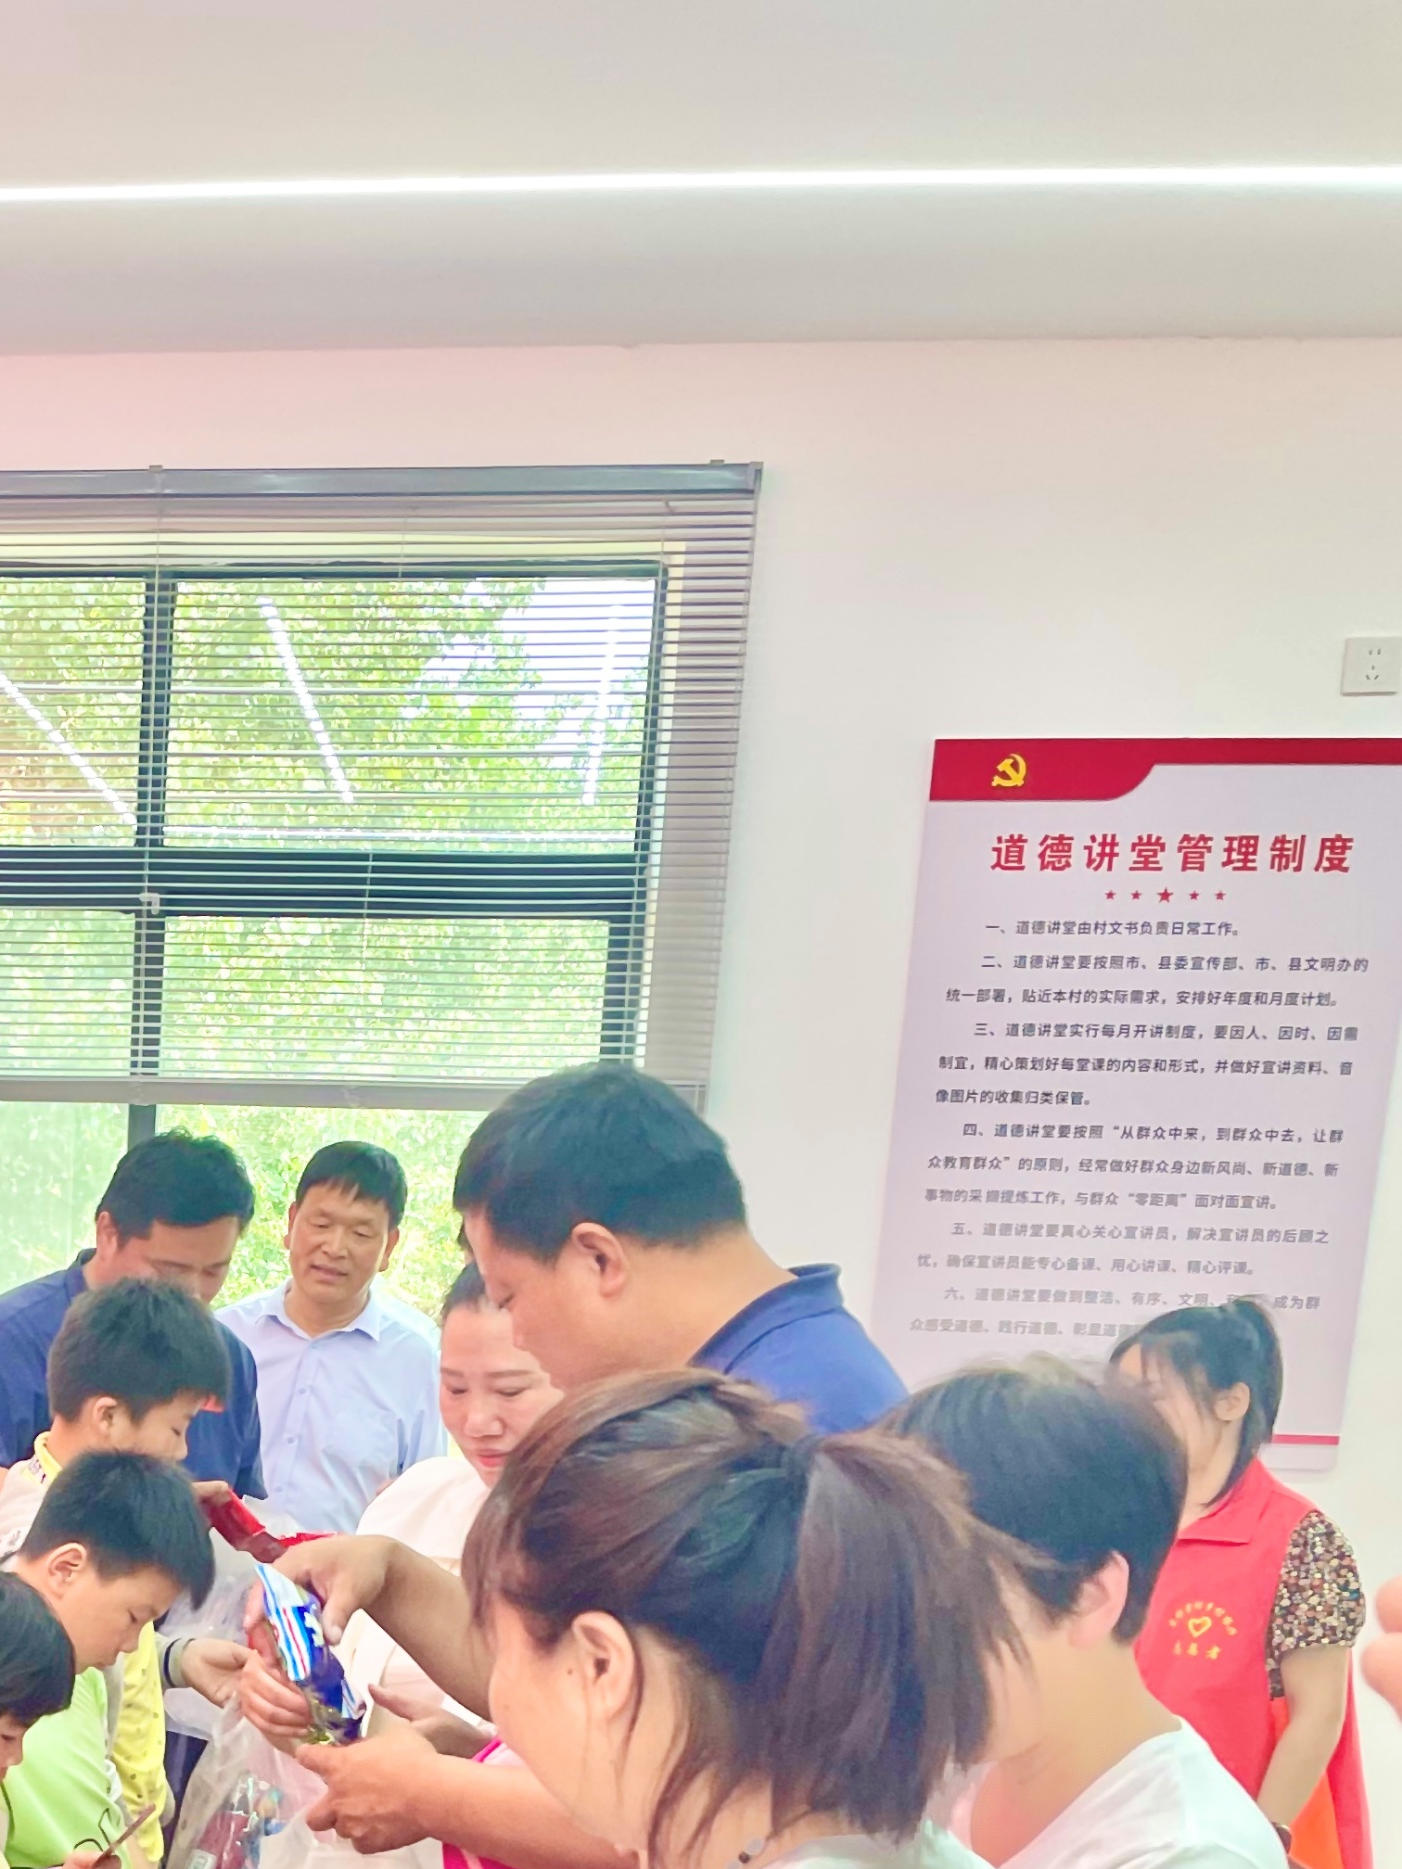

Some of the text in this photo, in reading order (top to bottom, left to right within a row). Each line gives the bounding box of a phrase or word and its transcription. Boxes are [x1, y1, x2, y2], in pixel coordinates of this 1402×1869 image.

[990, 833, 1355, 873] 道德讲堂管理制度
